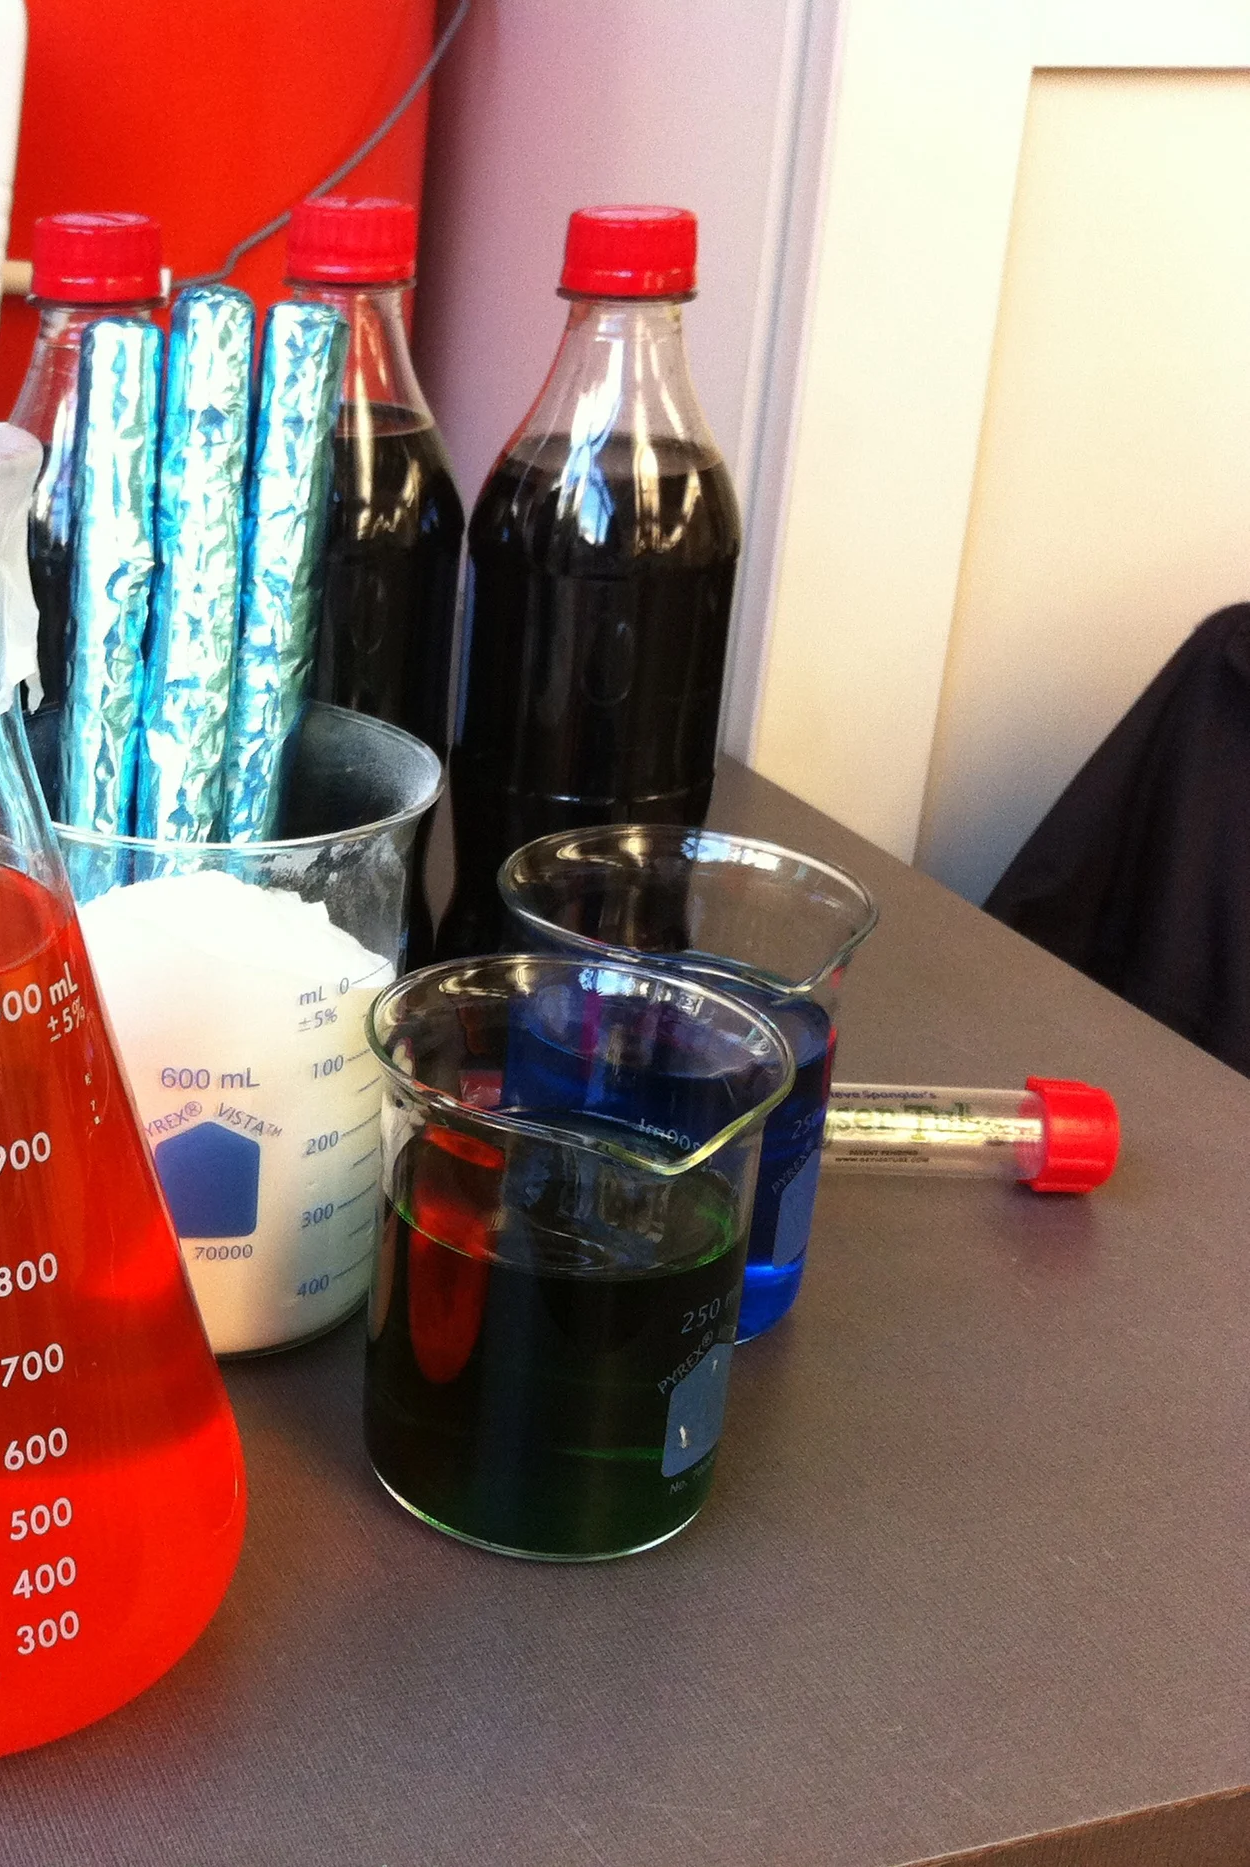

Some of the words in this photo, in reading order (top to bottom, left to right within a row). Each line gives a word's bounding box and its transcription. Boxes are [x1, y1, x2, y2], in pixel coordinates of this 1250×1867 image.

[49, 961, 79, 1006] mL
[299, 985, 327, 1006] mL
[339, 977, 350, 995] 0
[161, 1067, 211, 1090] 600
[220, 1067, 260, 1089] mL
[312, 1054, 344, 1080] 100
[143, 1101, 203, 1138] YREX®
[305, 1130, 339, 1156] 200
[301, 1203, 334, 1229] 300
[194, 1243, 254, 1261] 70000
[296, 1274, 330, 1298] 400
[681, 1298, 721, 1335] 250
[0, 1343, 64, 1388] 700
[4, 1427, 68, 1471] 600
[10, 1497, 73, 1541] 500
[12, 1556, 77, 1600] 400
[16, 1610, 80, 1655] 300
